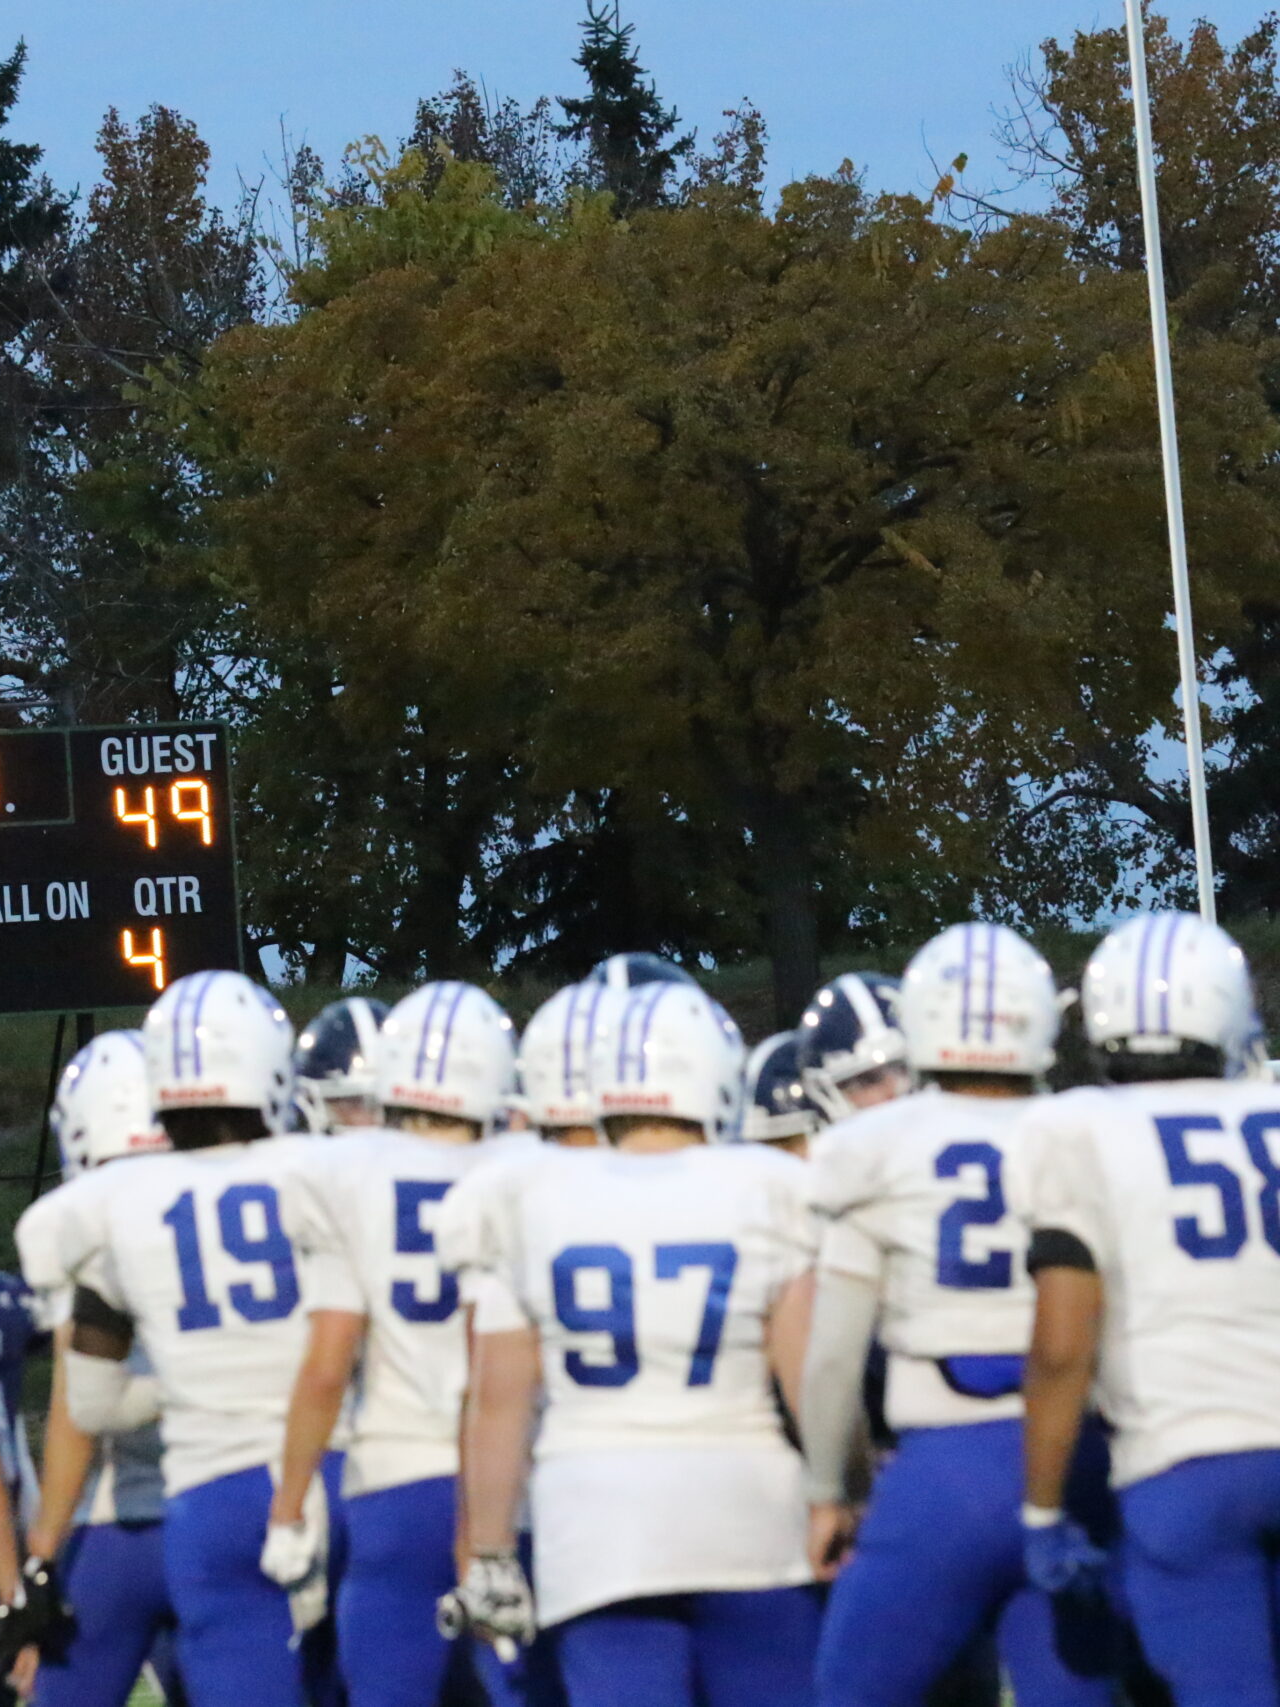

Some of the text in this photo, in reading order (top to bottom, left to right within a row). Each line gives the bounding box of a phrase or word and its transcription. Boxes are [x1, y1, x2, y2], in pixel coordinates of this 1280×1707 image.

[101, 734, 217, 776] GUEST
[115, 779, 212, 848] 49
[47, 882, 90, 921] ON
[134, 876, 202, 917] QTR
[122, 928, 165, 990] 4
[935, 1142, 1013, 1288] 2
[163, 1184, 300, 1332] 19
[552, 1244, 738, 1387] 97
